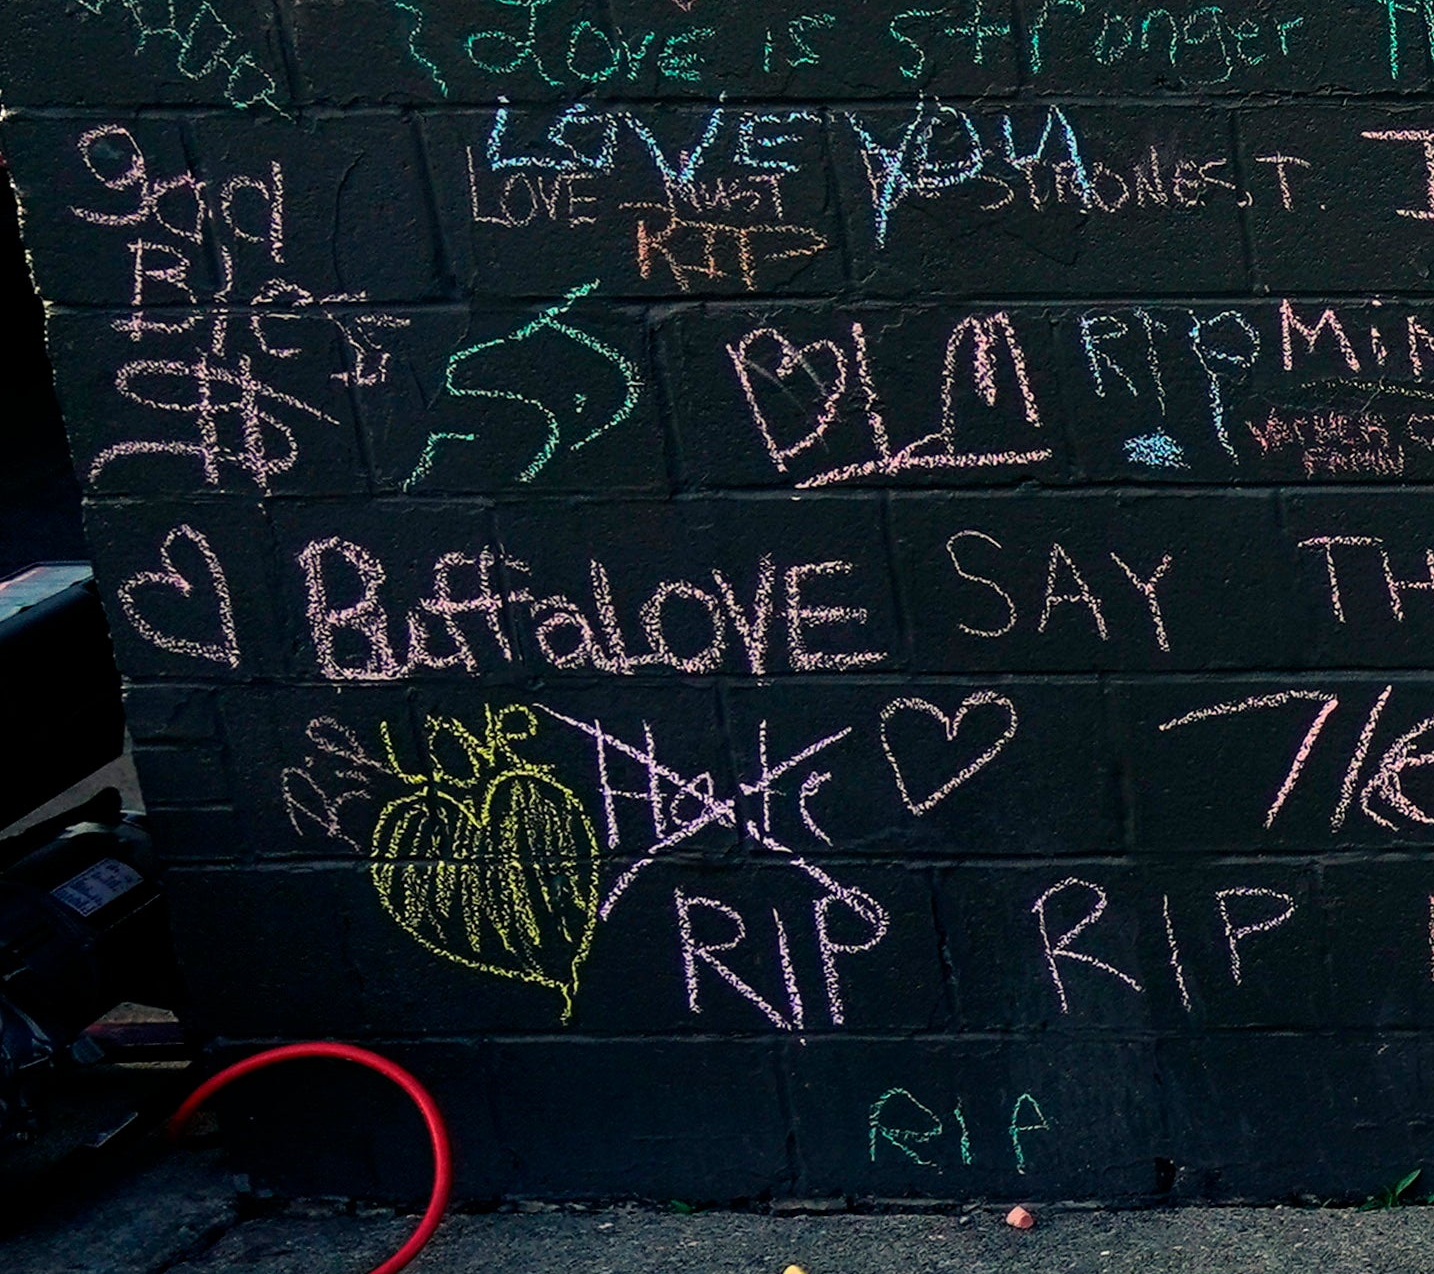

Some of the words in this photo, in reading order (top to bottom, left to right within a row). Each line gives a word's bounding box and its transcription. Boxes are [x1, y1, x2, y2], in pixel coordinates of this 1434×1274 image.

[945, 529, 1173, 653] SAY
[673, 882, 891, 1047] RIP
[1030, 876, 1299, 1014] RIP
